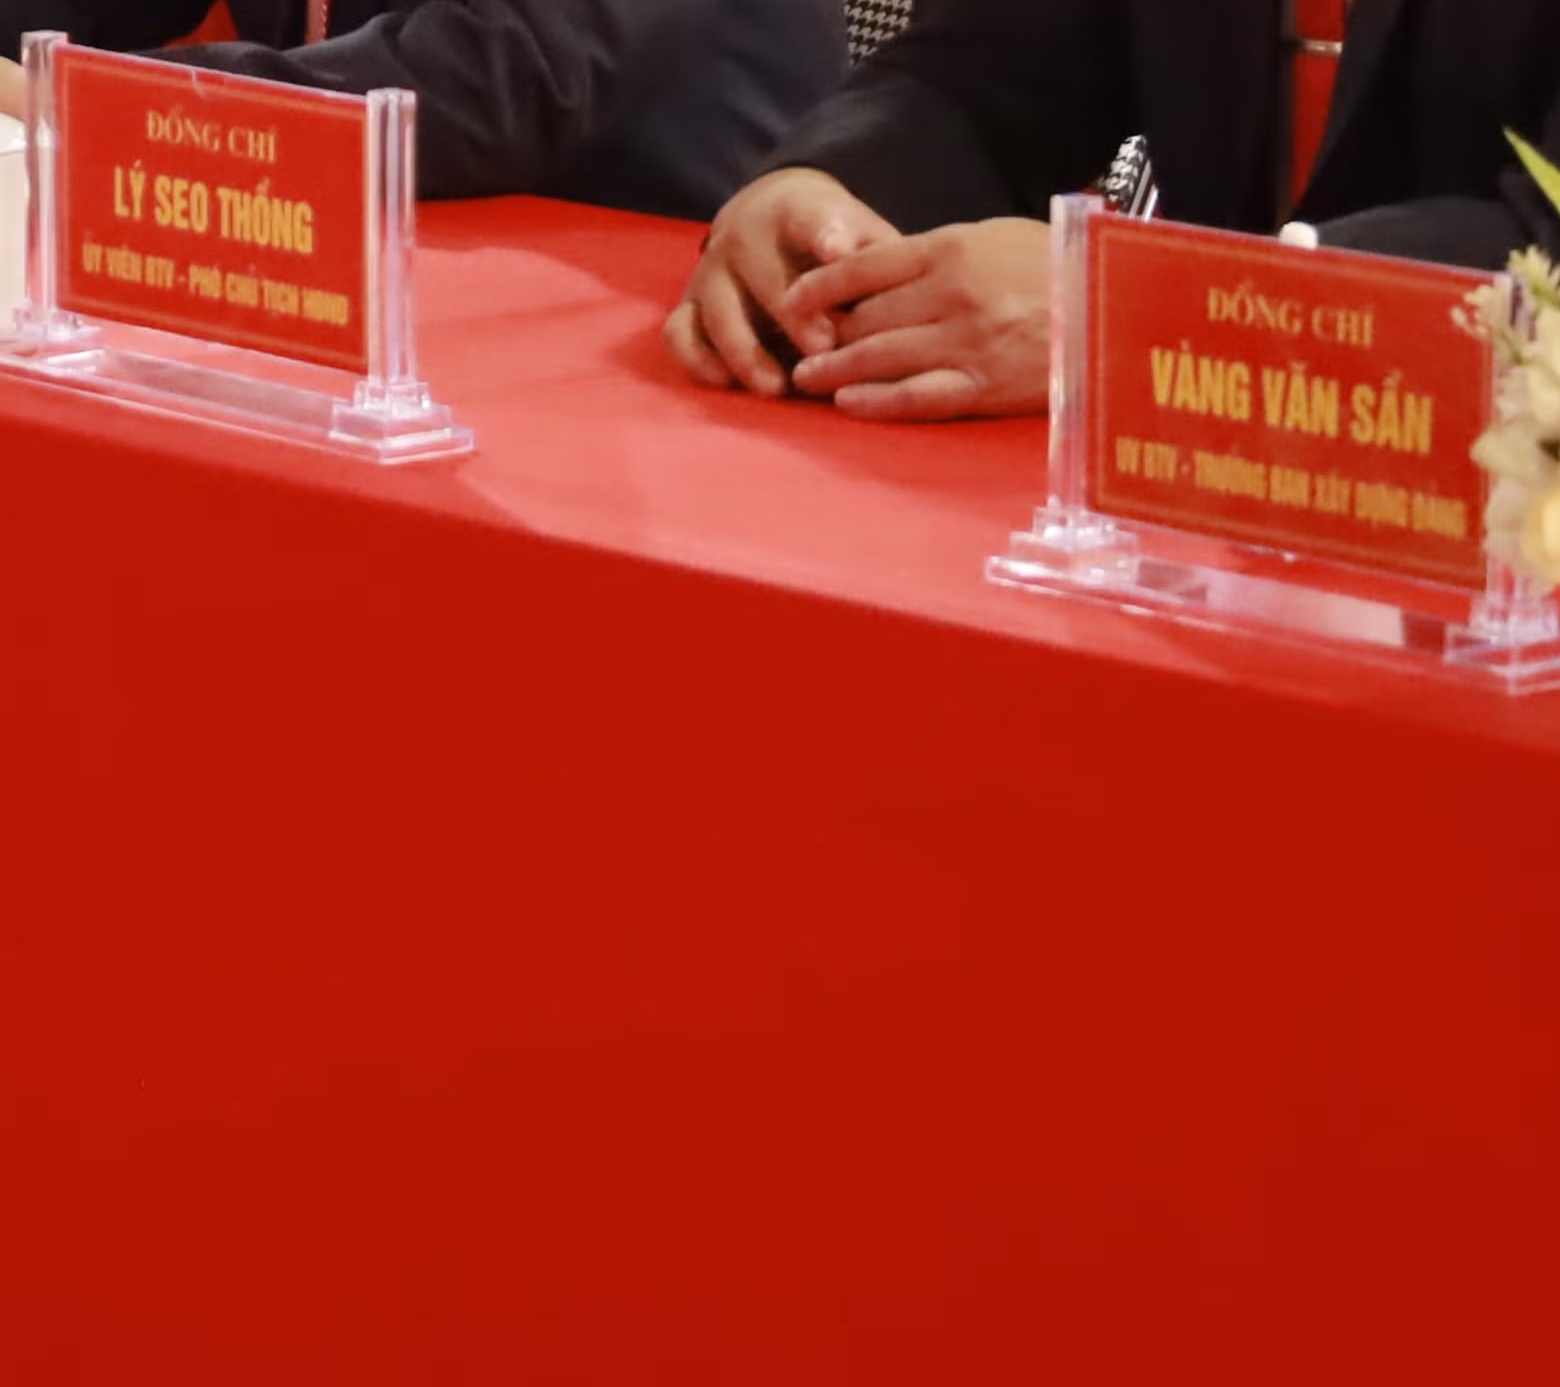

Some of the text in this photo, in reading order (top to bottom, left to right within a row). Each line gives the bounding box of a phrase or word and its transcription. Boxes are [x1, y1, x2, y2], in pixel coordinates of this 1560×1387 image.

[145, 104, 277, 164] ĐỒNG CHÍ
[113, 159, 314, 255] LÝ SEO THỐNG
[105, 247, 143, 283] VIÊN
[145, 254, 175, 289] BTV
[188, 261, 223, 301] PHÓ
[225, 263, 260, 308] CHỦ
[262, 278, 301, 317] TỊCH
[1206, 279, 1374, 347] ĐỒNG CHÍ
[1150, 339, 1251, 422] VÀNG
[1261, 360, 1340, 439] VĂN
[1269, 465, 1310, 509] BAN
[1313, 468, 1351, 517] XÂY
